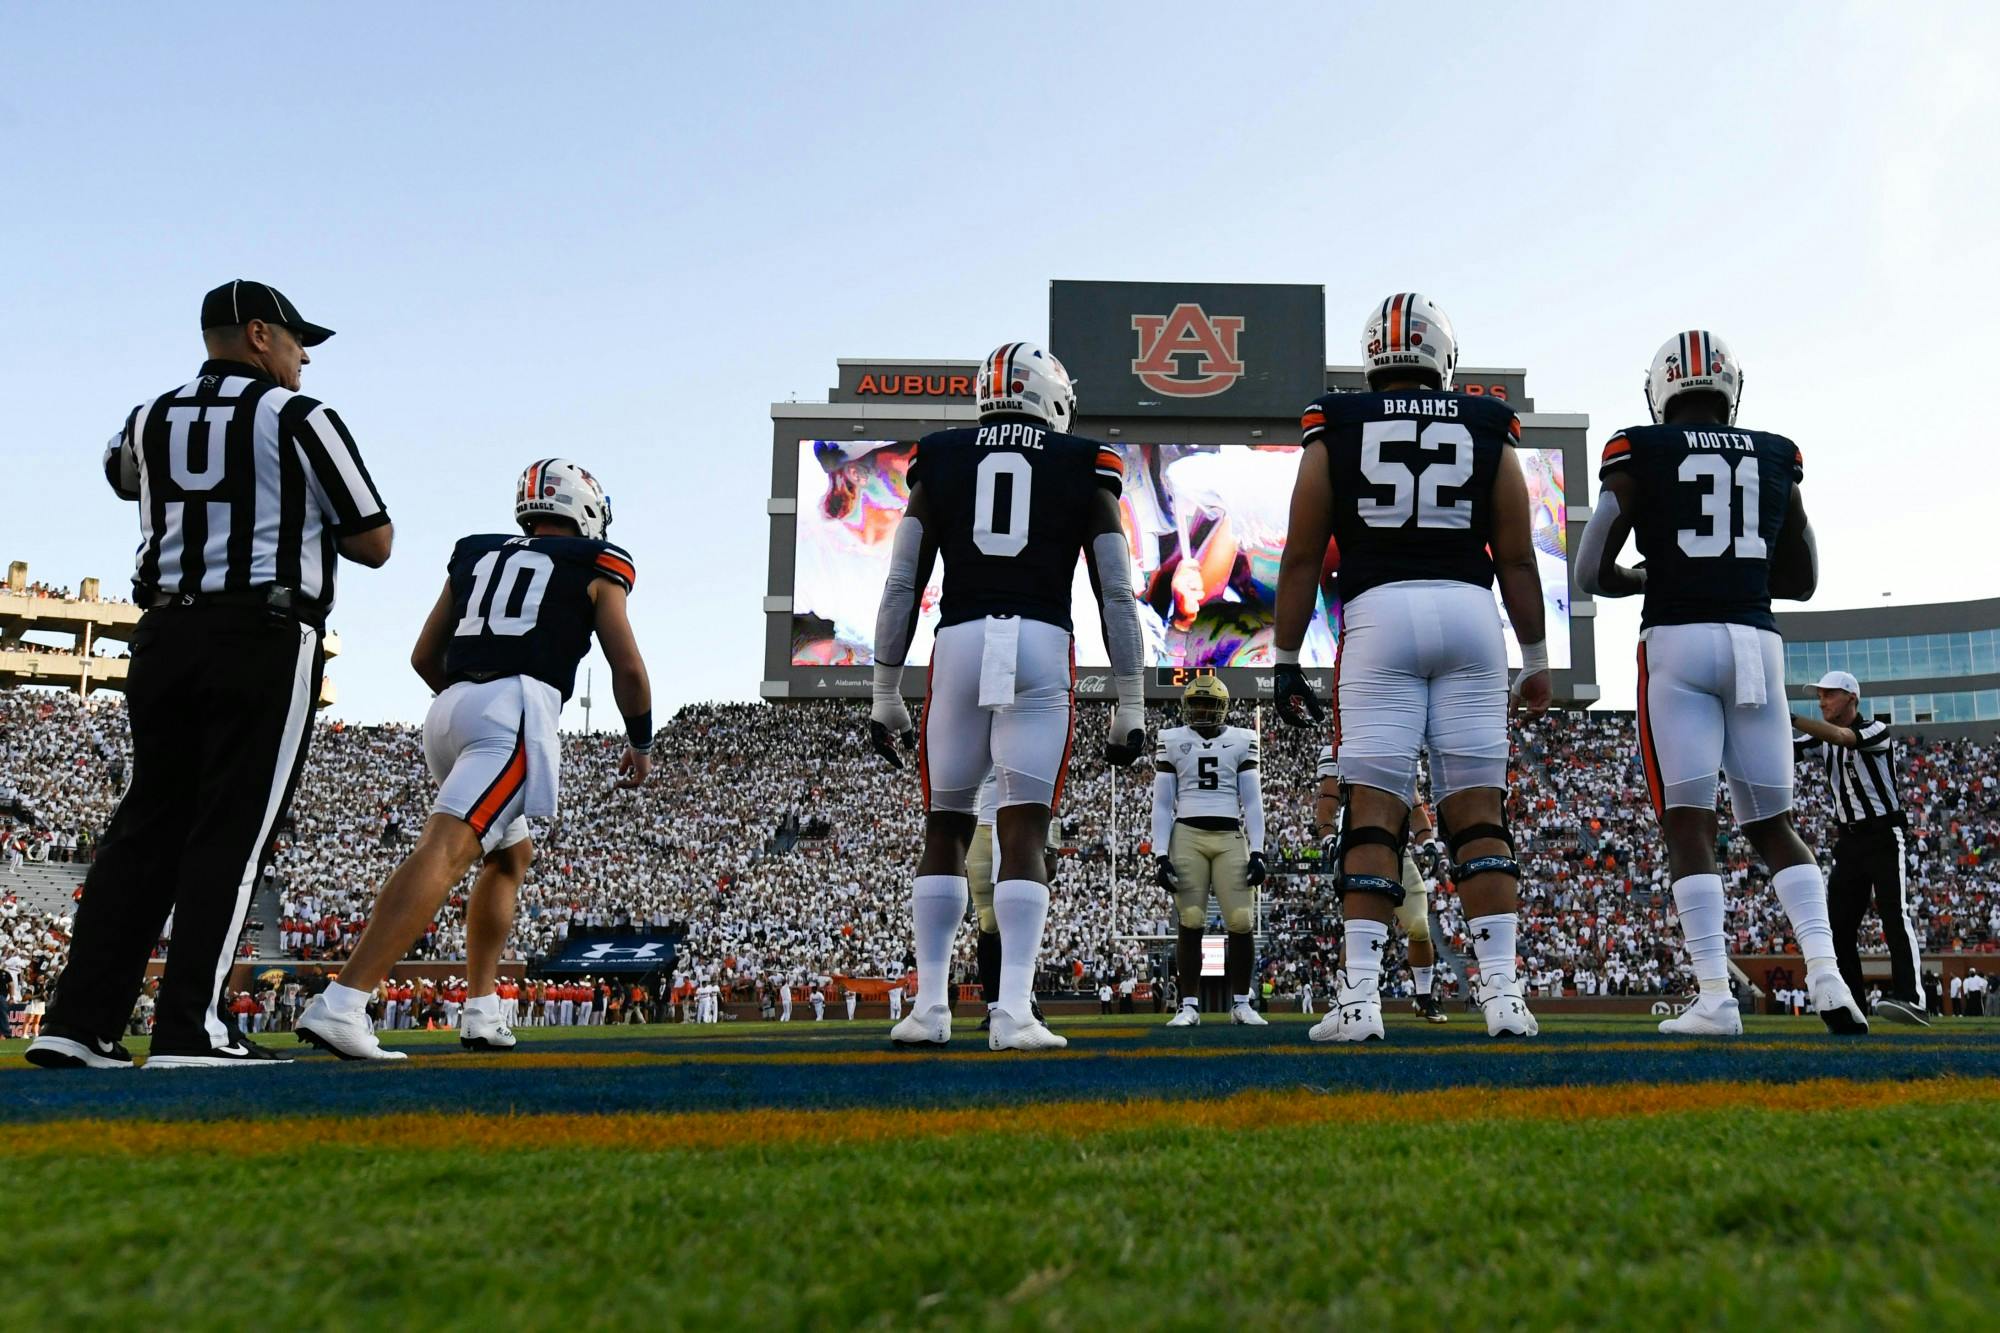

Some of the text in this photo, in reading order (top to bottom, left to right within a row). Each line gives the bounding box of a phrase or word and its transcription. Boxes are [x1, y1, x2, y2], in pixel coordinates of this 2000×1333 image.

[1373, 354, 1420, 366] WAR EAGLE
[856, 373, 978, 396] AUBUR
[1681, 380, 1694, 388] WAR
[980, 400, 1023, 413] WAR EAGLE
[1383, 398, 1459, 417] BRAHMS
[975, 423, 1046, 450] PAPPOE
[1682, 430, 1755, 452] WOOTEN
[165, 406, 236, 491] U
[1357, 419, 1474, 529] 52
[529, 502, 555, 511] EAGLE
[972, 451, 1033, 558] 0
[1677, 453, 1767, 560] 31
[454, 549, 555, 637] 10
[1198, 757, 1218, 790] 5
[1848, 767, 1857, 779] R
